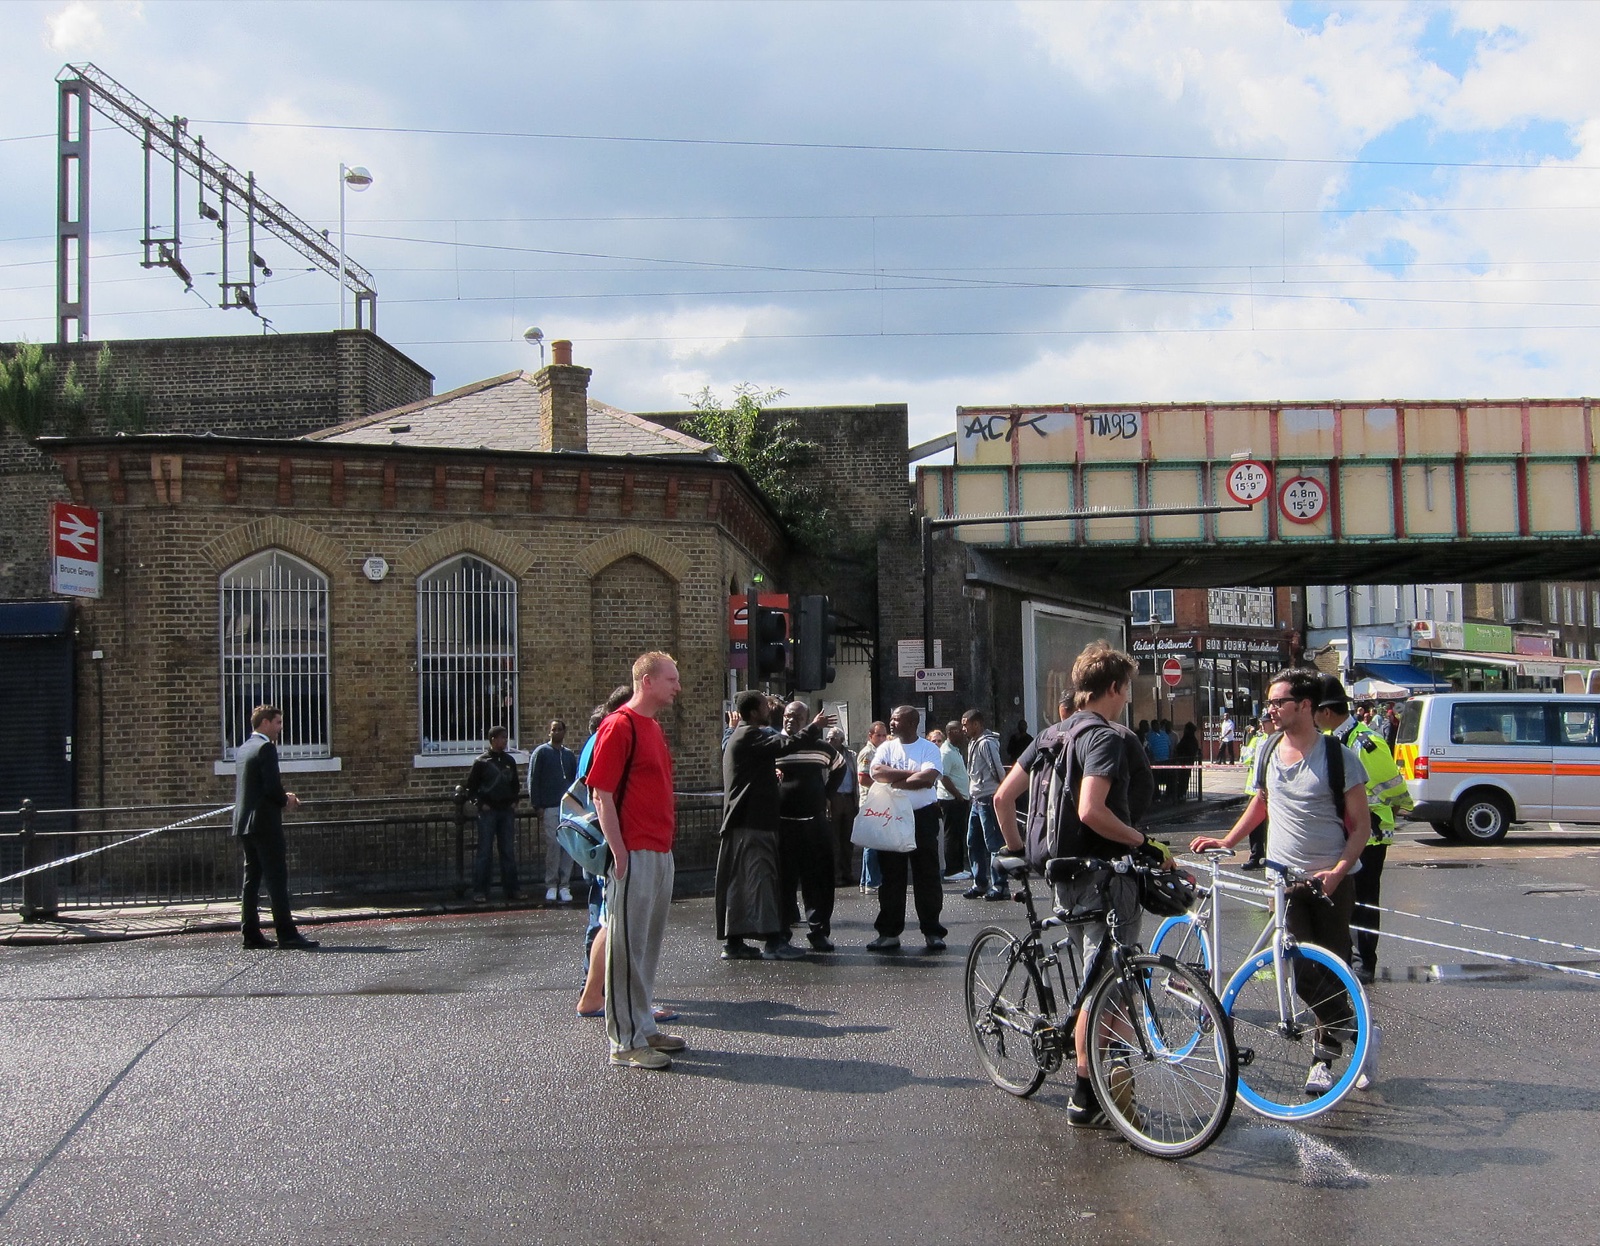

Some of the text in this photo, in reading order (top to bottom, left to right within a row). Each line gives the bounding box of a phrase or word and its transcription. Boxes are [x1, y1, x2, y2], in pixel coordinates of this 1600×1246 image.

[60, 564, 94, 577] Bruce Grove
[735, 641, 748, 650] Bru
